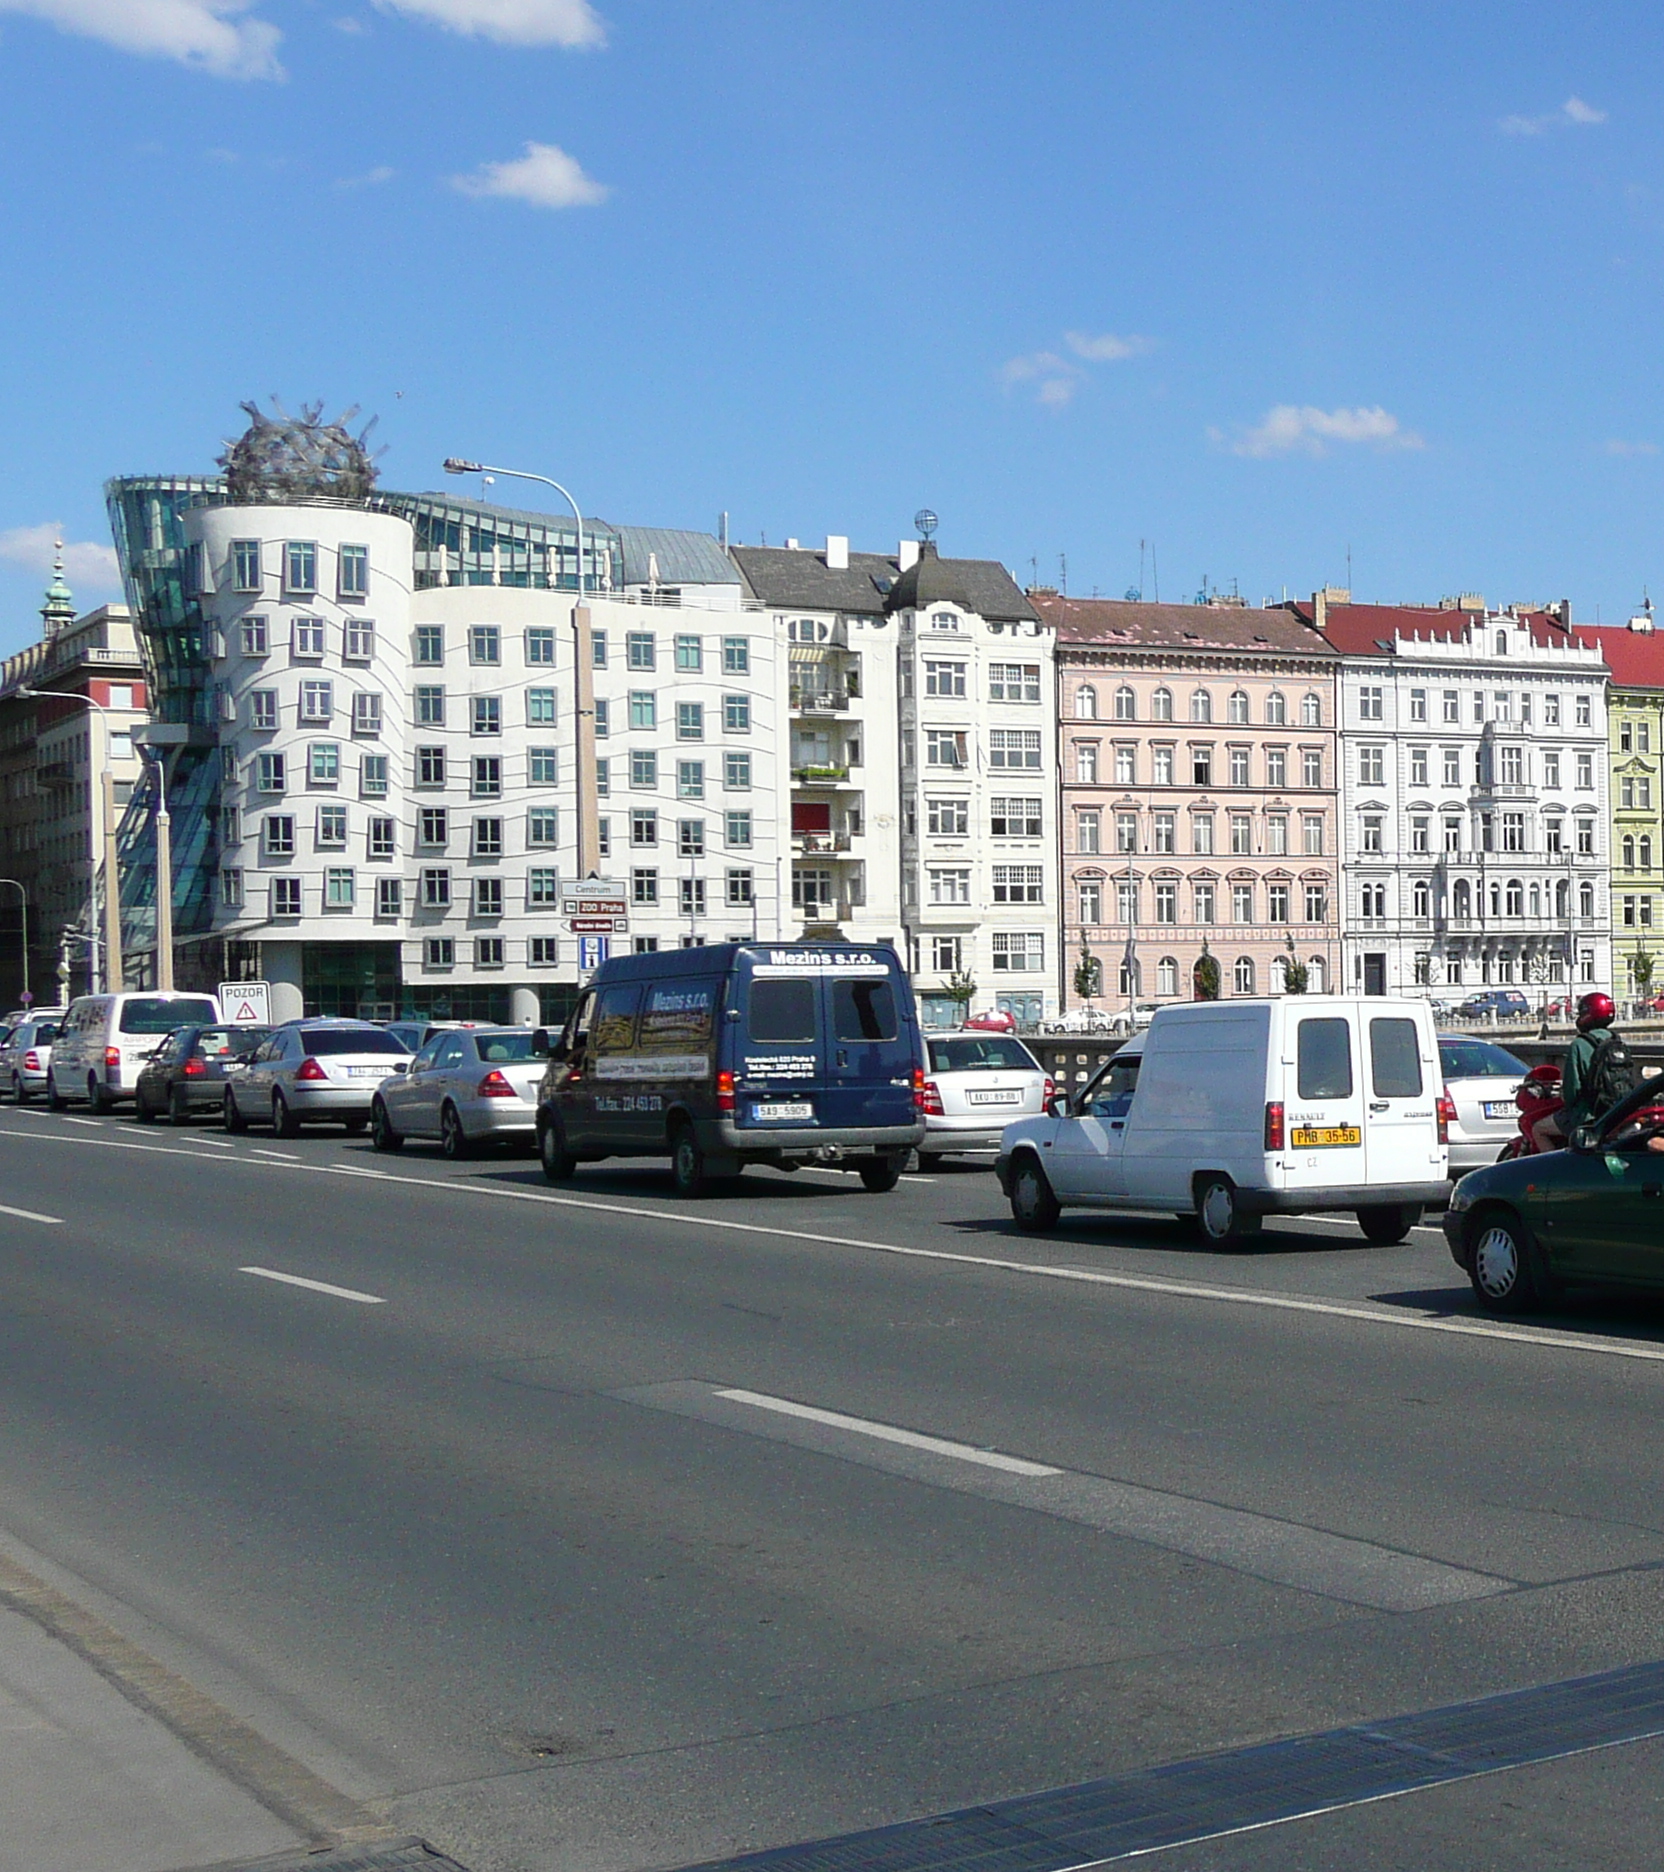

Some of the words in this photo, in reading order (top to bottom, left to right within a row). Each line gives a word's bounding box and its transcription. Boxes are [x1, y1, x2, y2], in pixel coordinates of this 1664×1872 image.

[575, 884, 611, 894] Centrum
[581, 902, 598, 912] ZOO
[600, 902, 624, 913] Praha
[770, 950, 832, 965] Mezins
[834, 951, 877, 965] s.r.o.
[225, 987, 264, 998] POZOR
[760, 1105, 778, 1116] 5A9
[784, 1104, 808, 1115] 5905
[1287, 1112, 1326, 1121] RENAULT
[1325, 1129, 1356, 1143] 35-56
